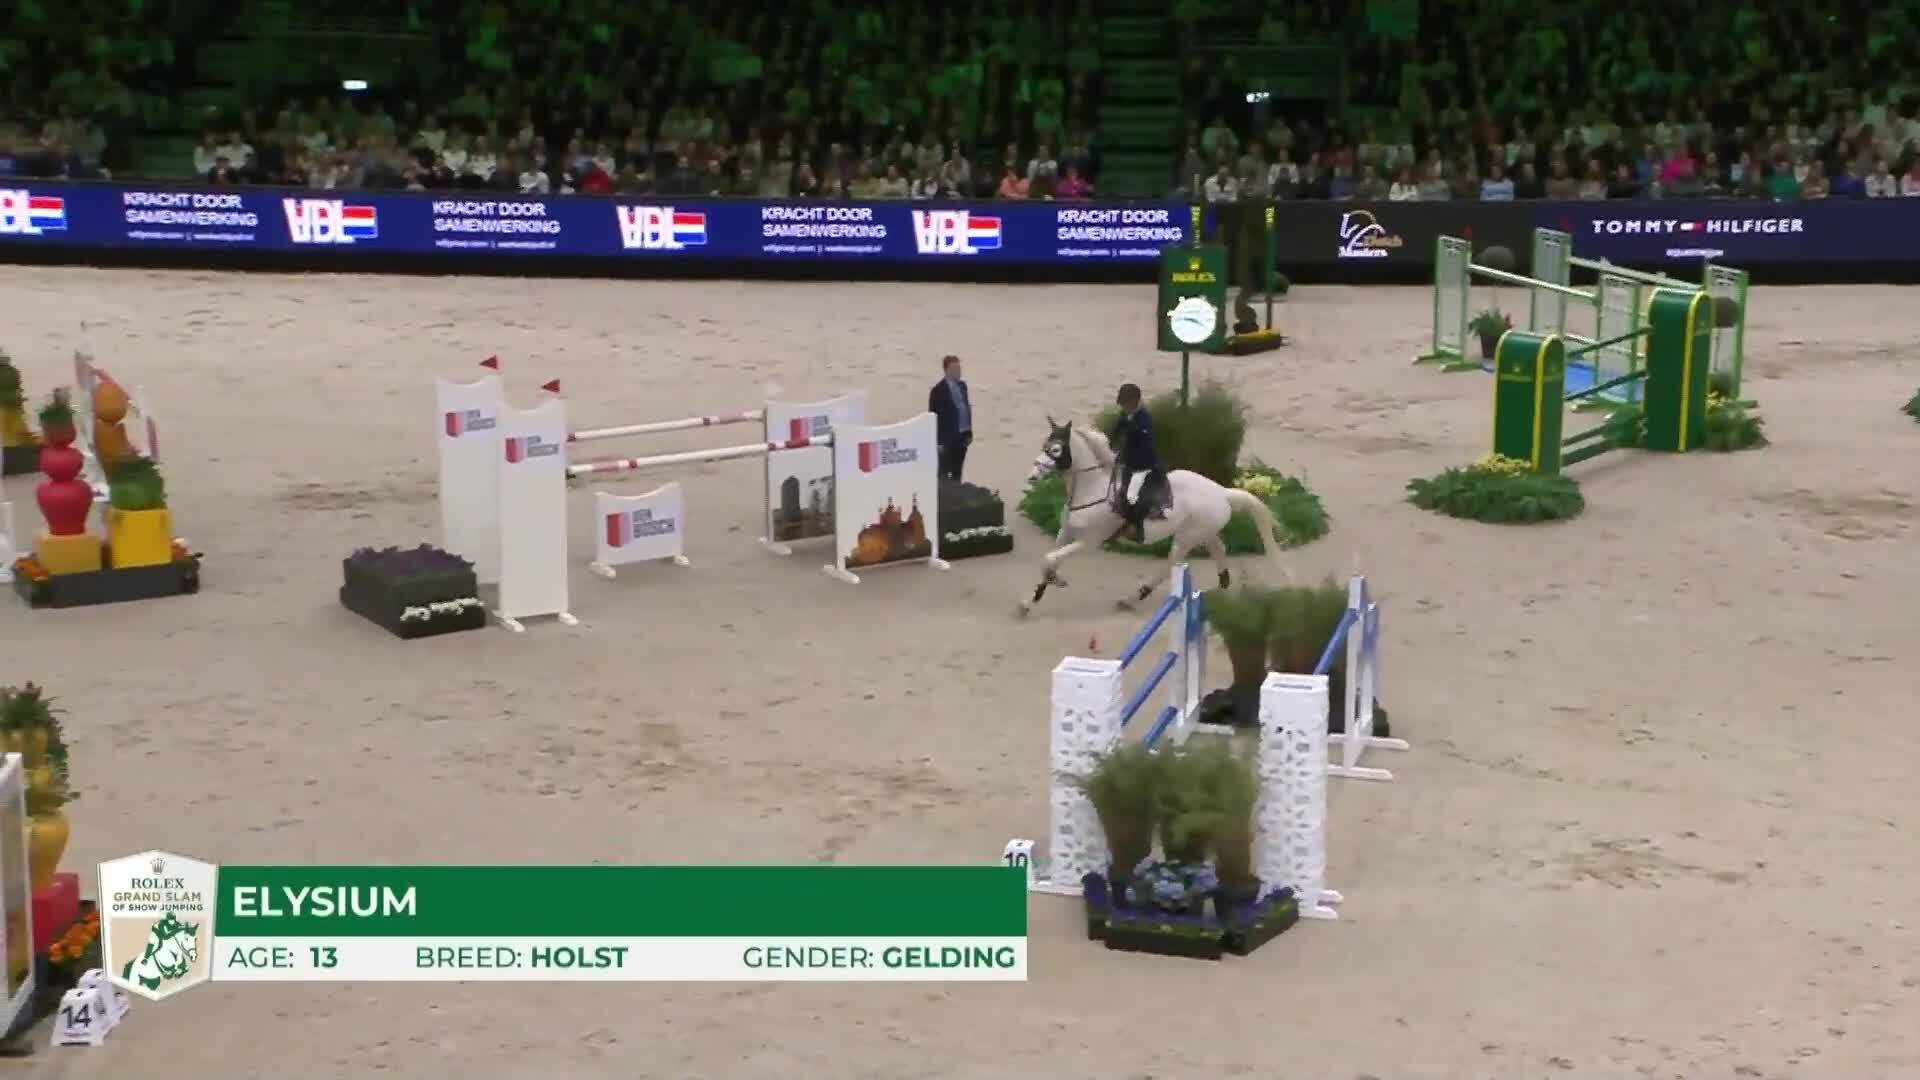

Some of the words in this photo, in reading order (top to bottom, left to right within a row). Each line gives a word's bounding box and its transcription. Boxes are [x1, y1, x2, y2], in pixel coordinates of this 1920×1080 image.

[123, 192, 191, 207] KRACHT
[192, 194, 242, 209] DOOR
[432, 200, 497, 216] KRACHT
[498, 202, 546, 217] DOOR
[0, 189, 42, 234] DL
[125, 209, 258, 226] SAMENWERKING
[761, 206, 825, 221] KRACHT
[826, 207, 873, 221] DOOR
[1057, 209, 1120, 224] KRACHT
[1121, 209, 1169, 224] DOOR
[283, 198, 356, 243] VDL
[433, 217, 562, 234] SAMENWERKING
[616, 205, 686, 249] VDL
[1592, 219, 1678, 234] TOMMY
[1706, 218, 1804, 233] HILFIGER
[762, 223, 888, 239] SAMENWERKING
[911, 209, 979, 254] VDL
[1057, 226, 1183, 241] SAMENWERKING
[61, 1004, 92, 1029] 14
